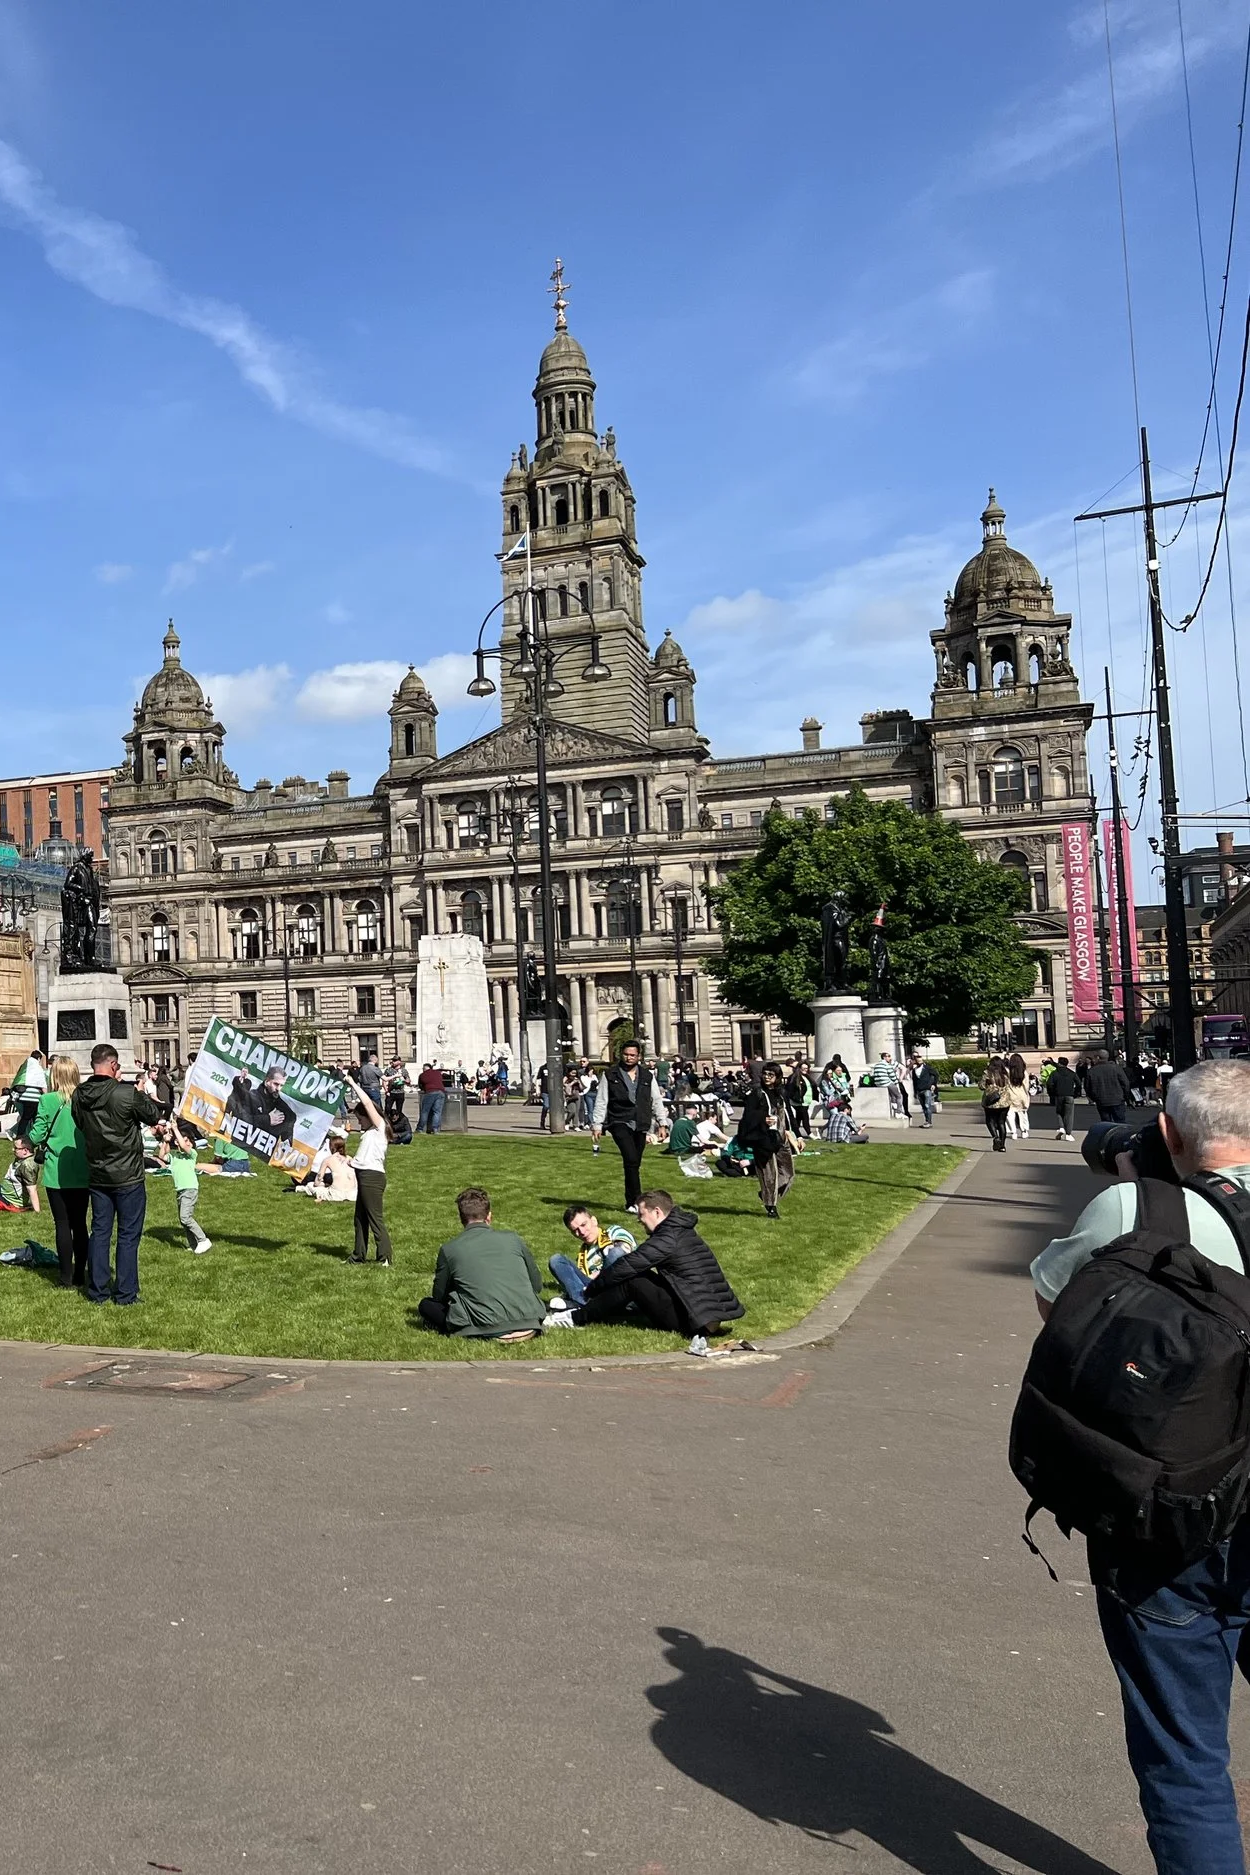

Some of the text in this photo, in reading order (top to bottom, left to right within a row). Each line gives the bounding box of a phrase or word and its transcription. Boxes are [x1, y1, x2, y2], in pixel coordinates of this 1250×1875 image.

[1067, 827, 1091, 982] PEOPLE MAKE GLASGOW
[210, 1071, 229, 1086] 2021
[215, 1026, 344, 1105] CHAMPIONS
[190, 1096, 309, 1172] WE NEVER STOP
